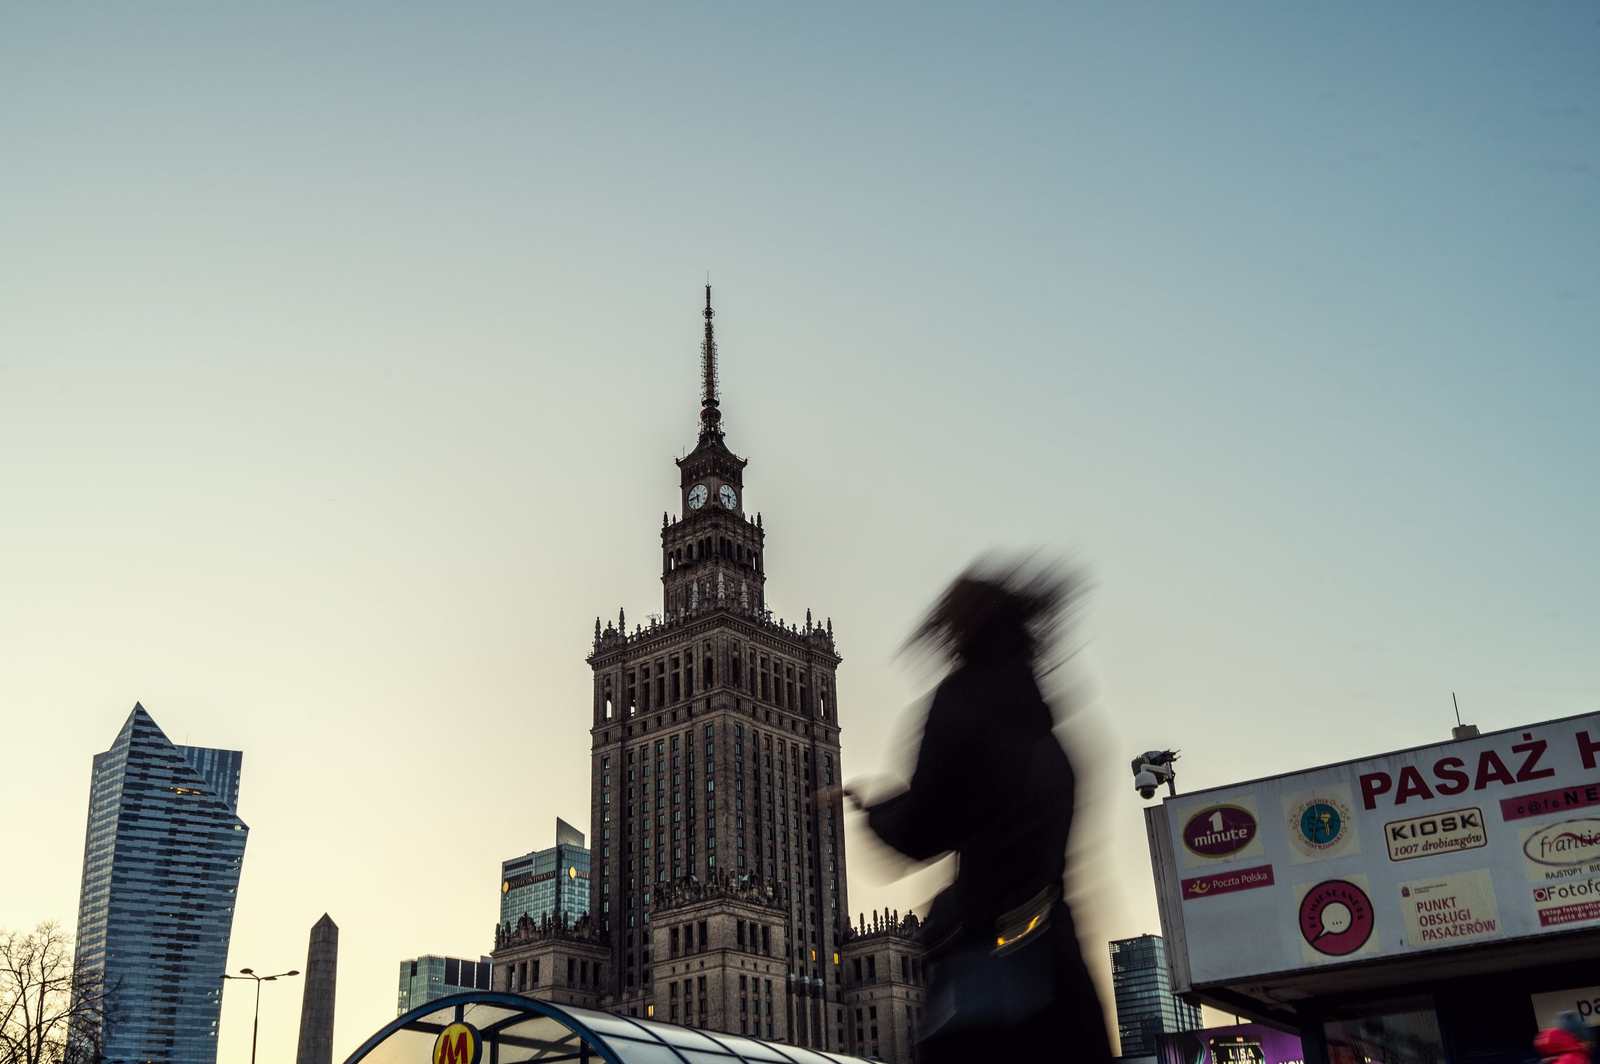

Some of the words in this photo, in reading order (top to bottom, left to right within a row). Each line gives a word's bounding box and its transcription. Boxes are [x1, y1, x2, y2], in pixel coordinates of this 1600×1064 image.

[1359, 733, 1555, 810] PASAŻ
[1209, 811, 1223, 832] 1
[1391, 813, 1479, 841] KIOSK
[1194, 828, 1248, 847] minute
[1394, 844, 1418, 856] 1007
[1422, 833, 1482, 851] drobiazgów
[1212, 878, 1240, 889] Poczta
[1241, 872, 1268, 885] Polska
[1416, 896, 1457, 913] PUNKT
[1419, 908, 1472, 927] OBSŁUGI
[1422, 918, 1496, 941] PASAŻERÓW
[438, 1031, 468, 1064] M
[1228, 1048, 1255, 1060] LISA
